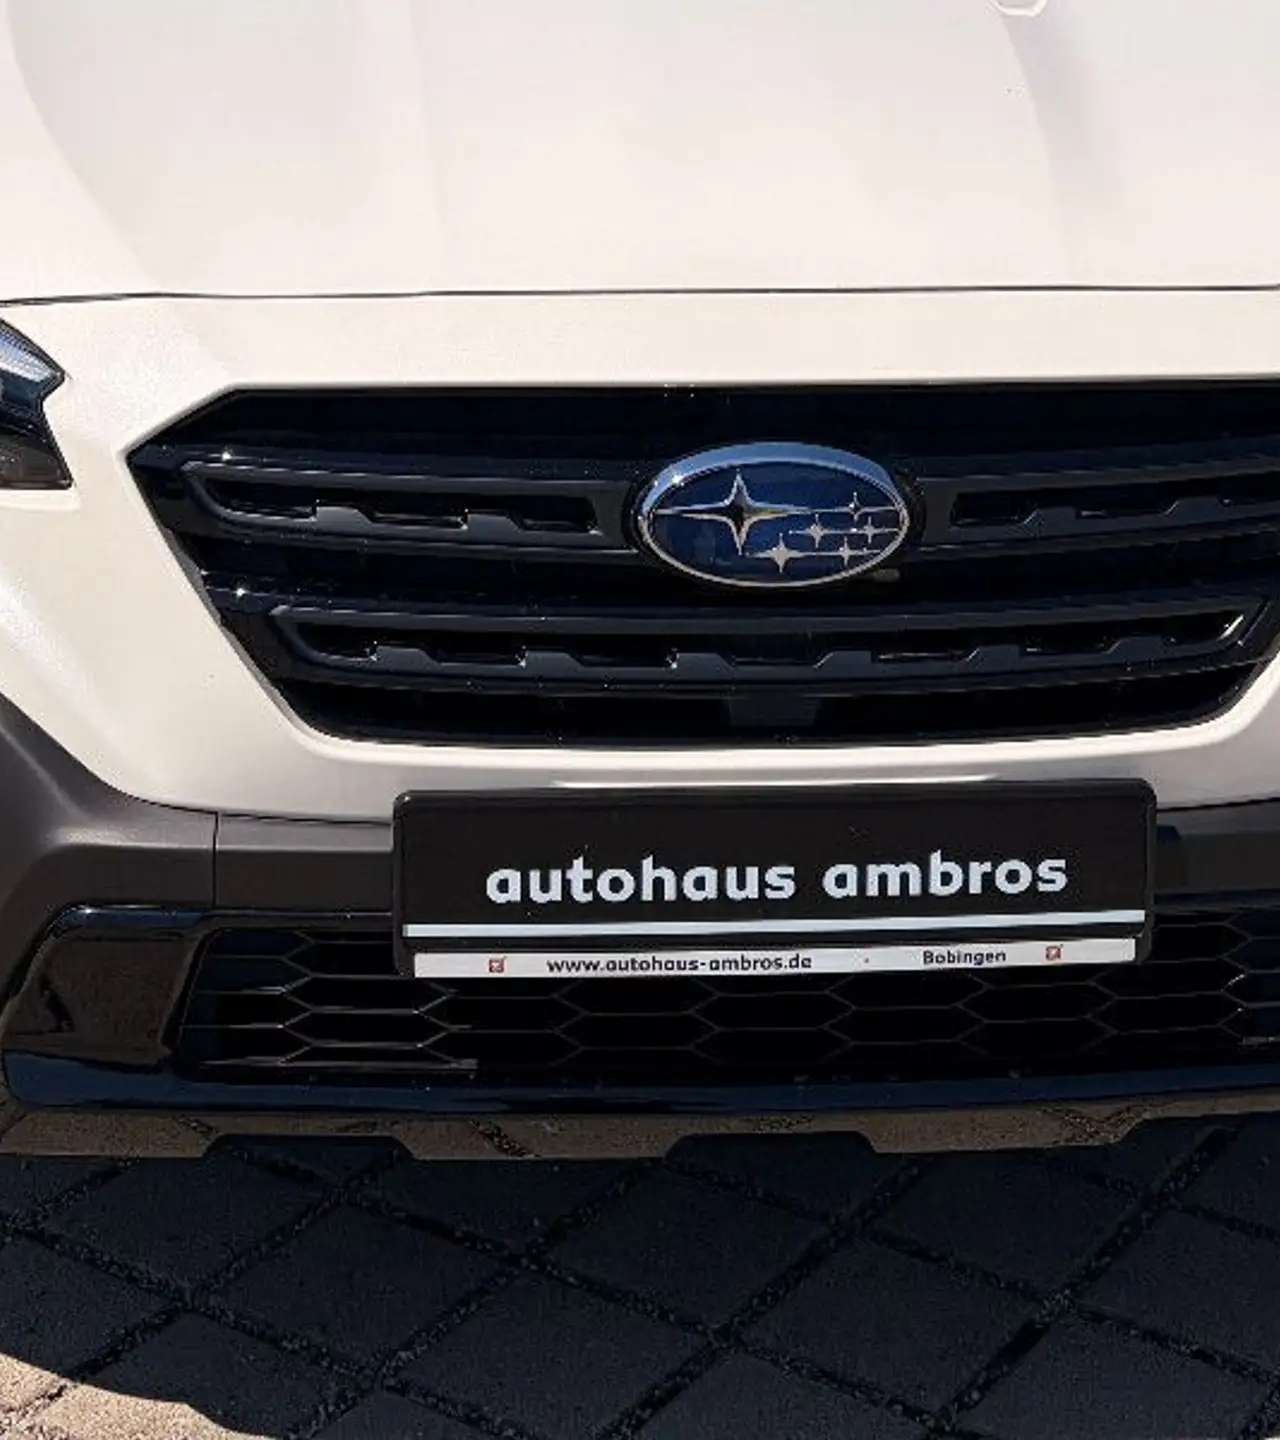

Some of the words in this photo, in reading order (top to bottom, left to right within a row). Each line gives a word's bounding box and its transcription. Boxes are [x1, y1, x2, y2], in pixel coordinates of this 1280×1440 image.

[486, 854, 797, 904] autohaus
[822, 850, 1069, 899] ambros
[546, 954, 812, 973] www.autohaus-ambros.de
[923, 950, 1007, 968] Bobingen
